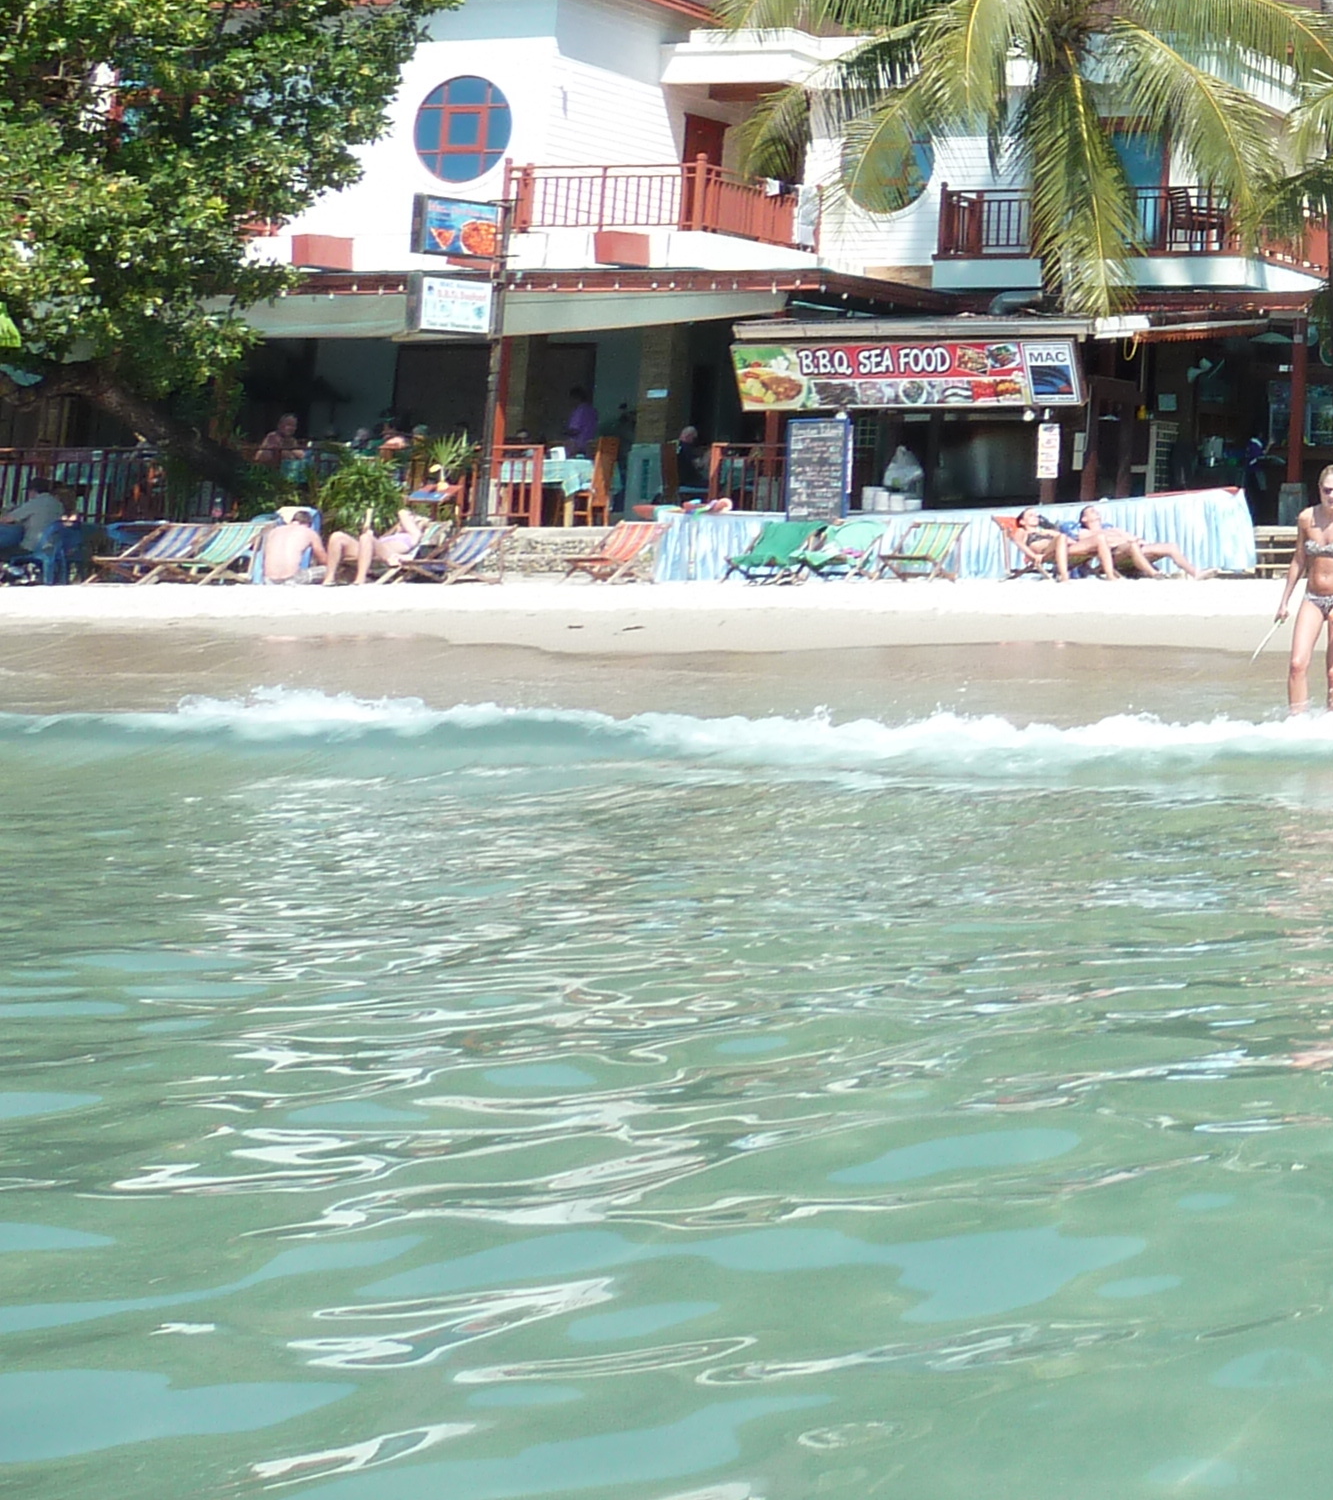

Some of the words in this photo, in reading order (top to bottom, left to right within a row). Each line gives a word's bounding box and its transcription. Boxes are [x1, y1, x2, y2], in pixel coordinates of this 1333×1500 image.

[858, 349, 893, 373] SEA
[899, 347, 950, 372] FOOD
[1029, 352, 1067, 362] MAC
